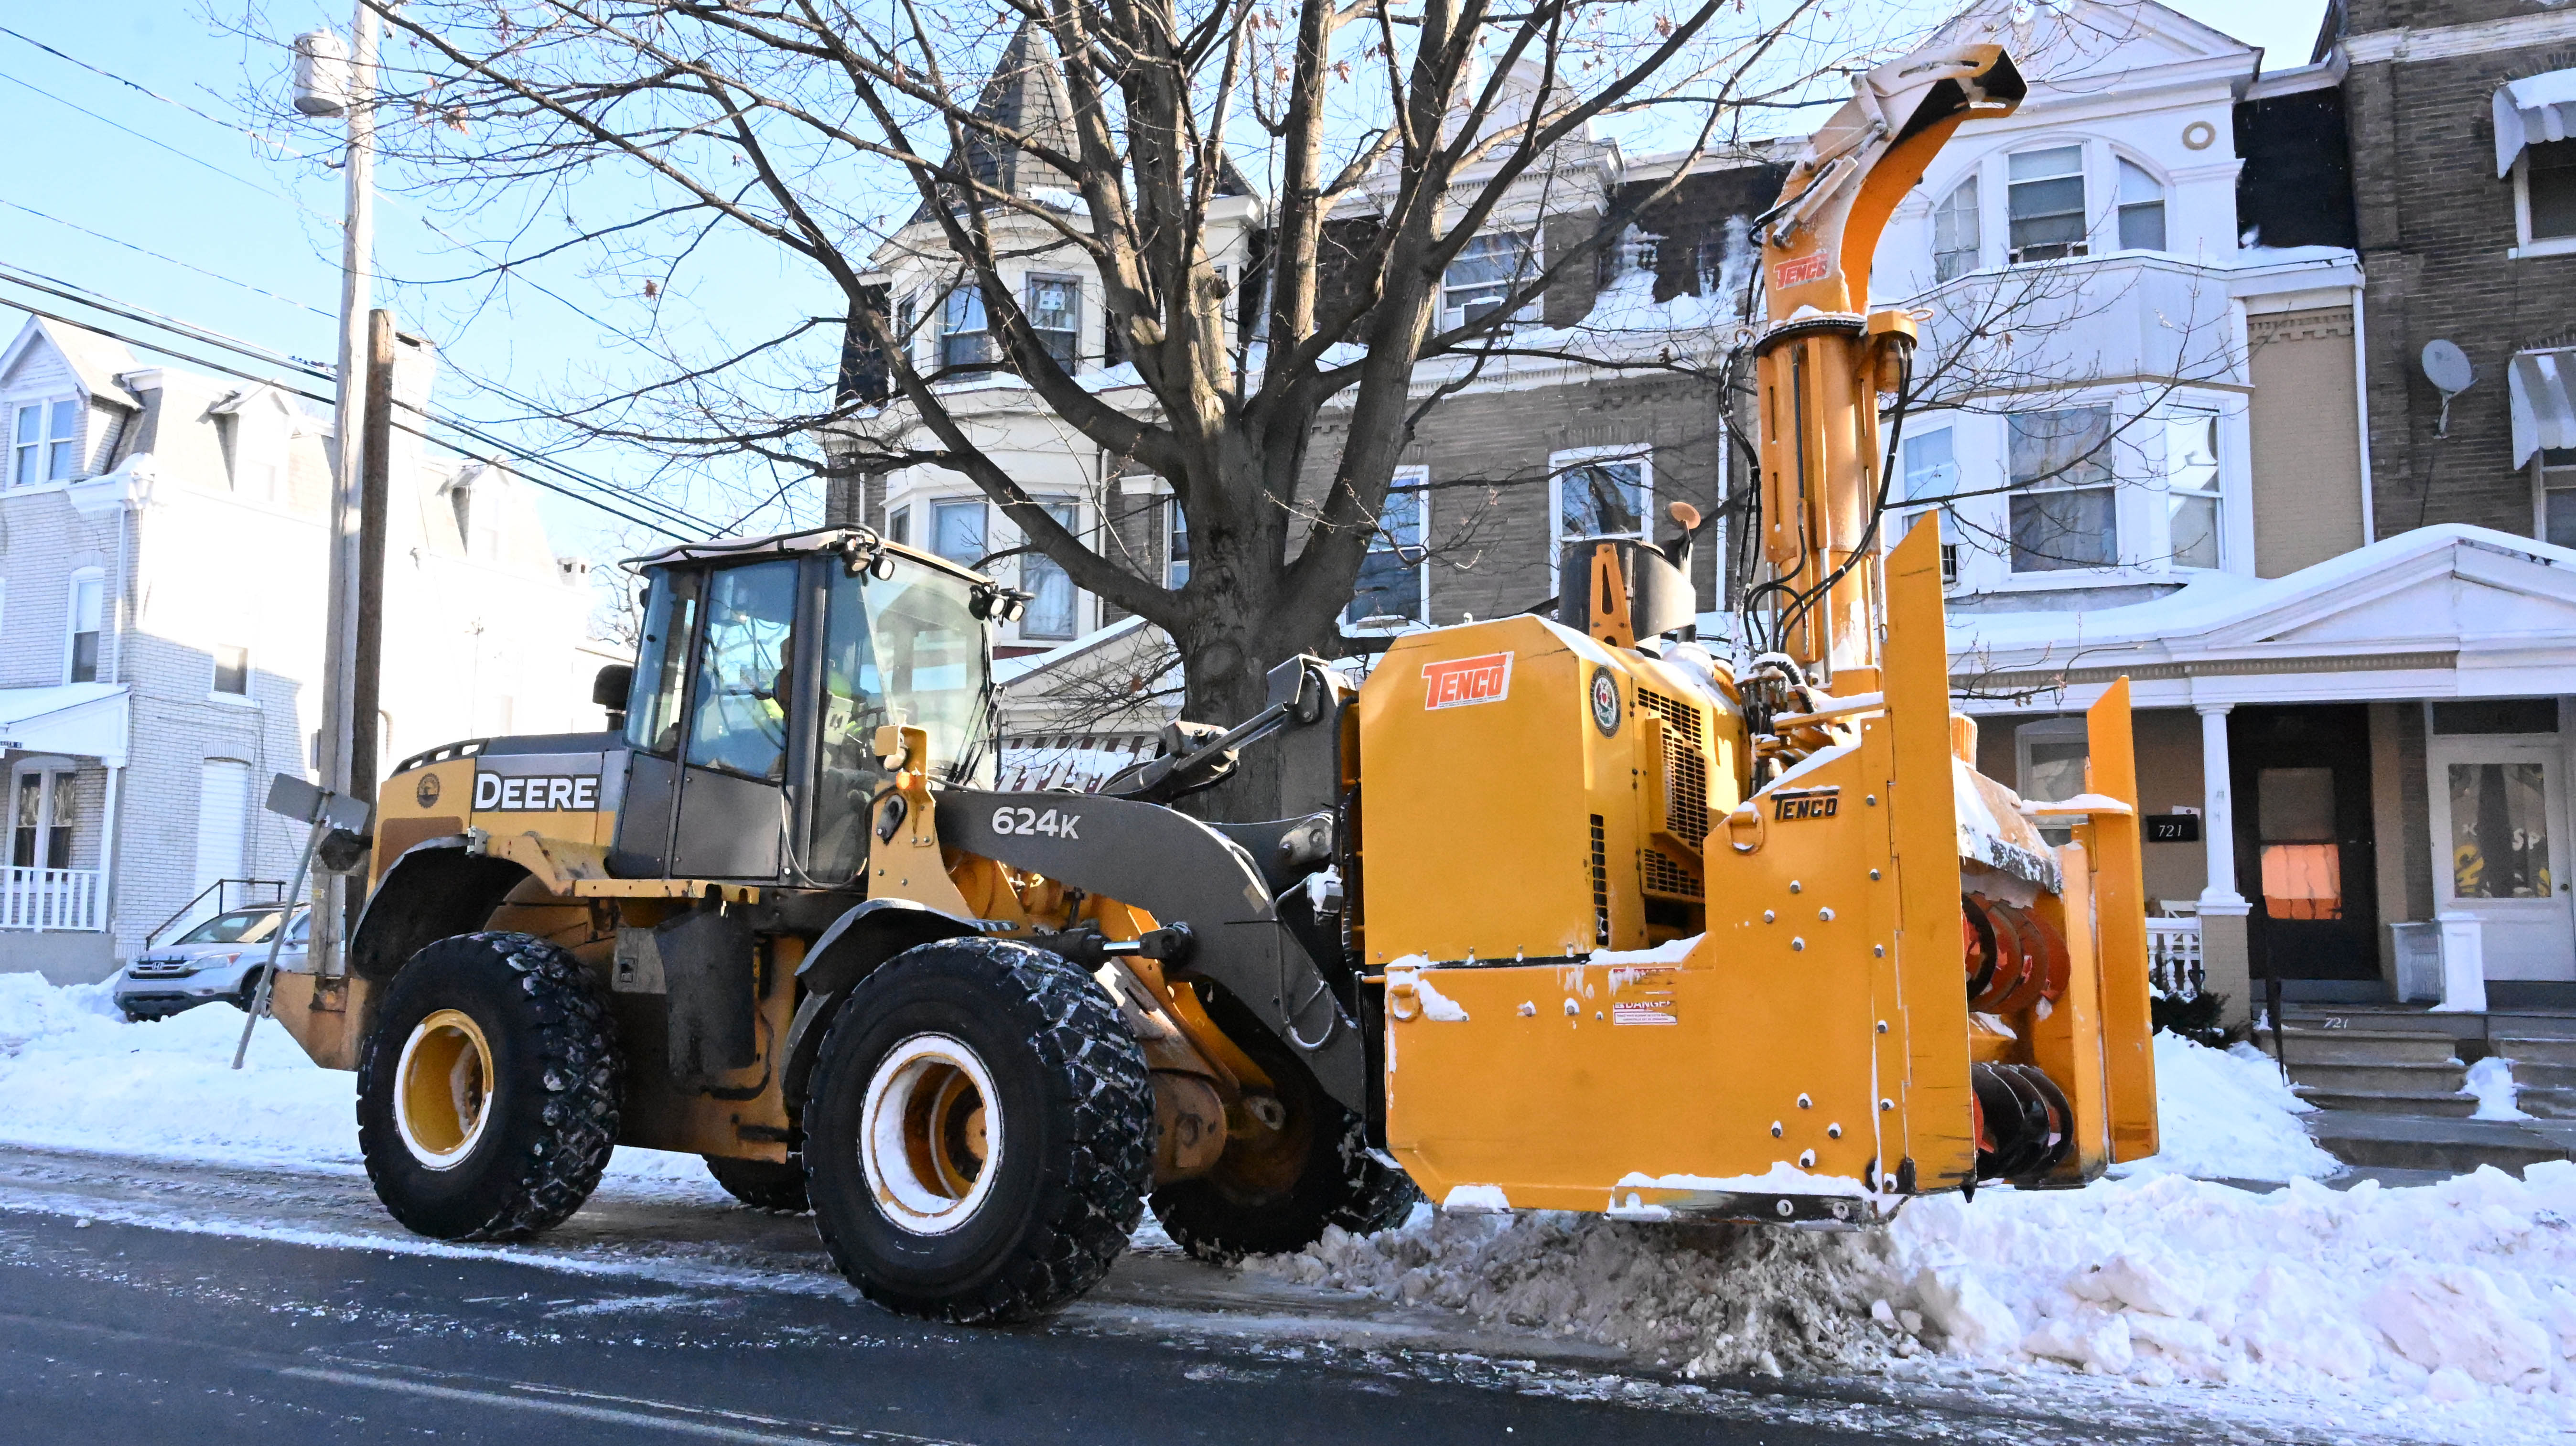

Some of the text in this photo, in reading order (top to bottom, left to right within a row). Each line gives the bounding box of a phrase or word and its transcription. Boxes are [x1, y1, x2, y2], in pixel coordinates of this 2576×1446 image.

[1774, 253, 1828, 289] TENCO
[1423, 654, 1507, 708] TENCO
[475, 773, 597, 808] DEERE
[1770, 789, 1839, 820] TENCO
[992, 807, 1081, 839] 624K
[2159, 825, 2182, 837] 721
[2323, 1017, 2349, 1029] 721
